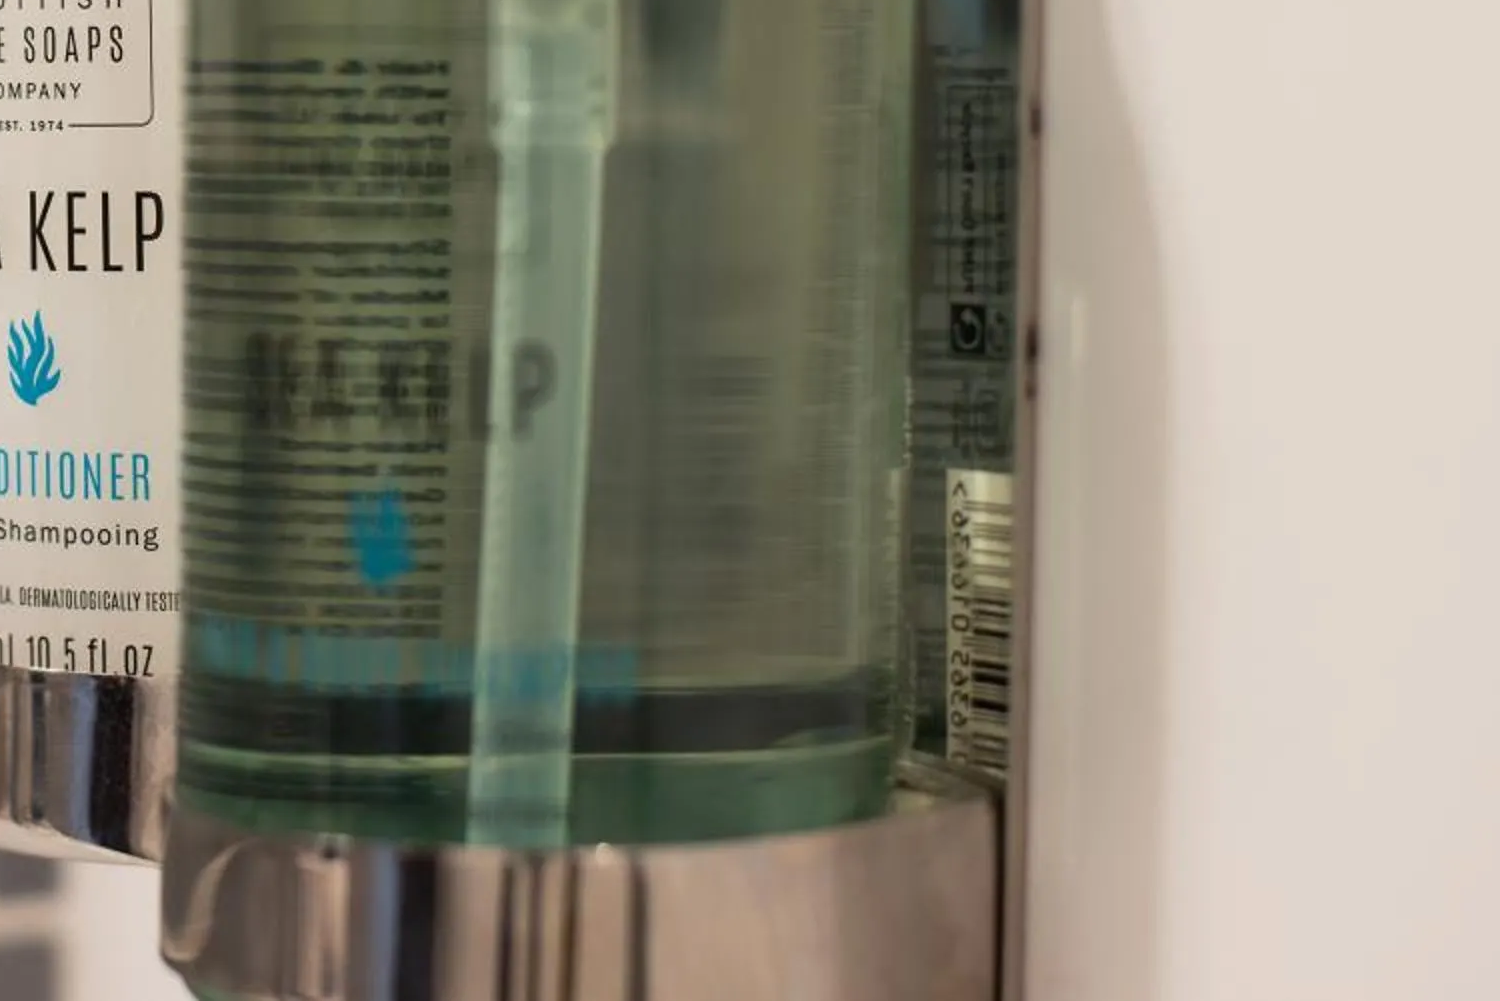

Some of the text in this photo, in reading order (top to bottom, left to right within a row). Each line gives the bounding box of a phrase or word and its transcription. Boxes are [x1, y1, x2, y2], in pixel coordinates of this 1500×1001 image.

[23, 25, 124, 64] SOAPS
[30, 120, 64, 131] 1974
[29, 190, 164, 272] KELP
[19, 586, 141, 612] DERMATOLOGICALLY
[145, 591, 182, 613] TESTE
[124, 644, 155, 677] oz
